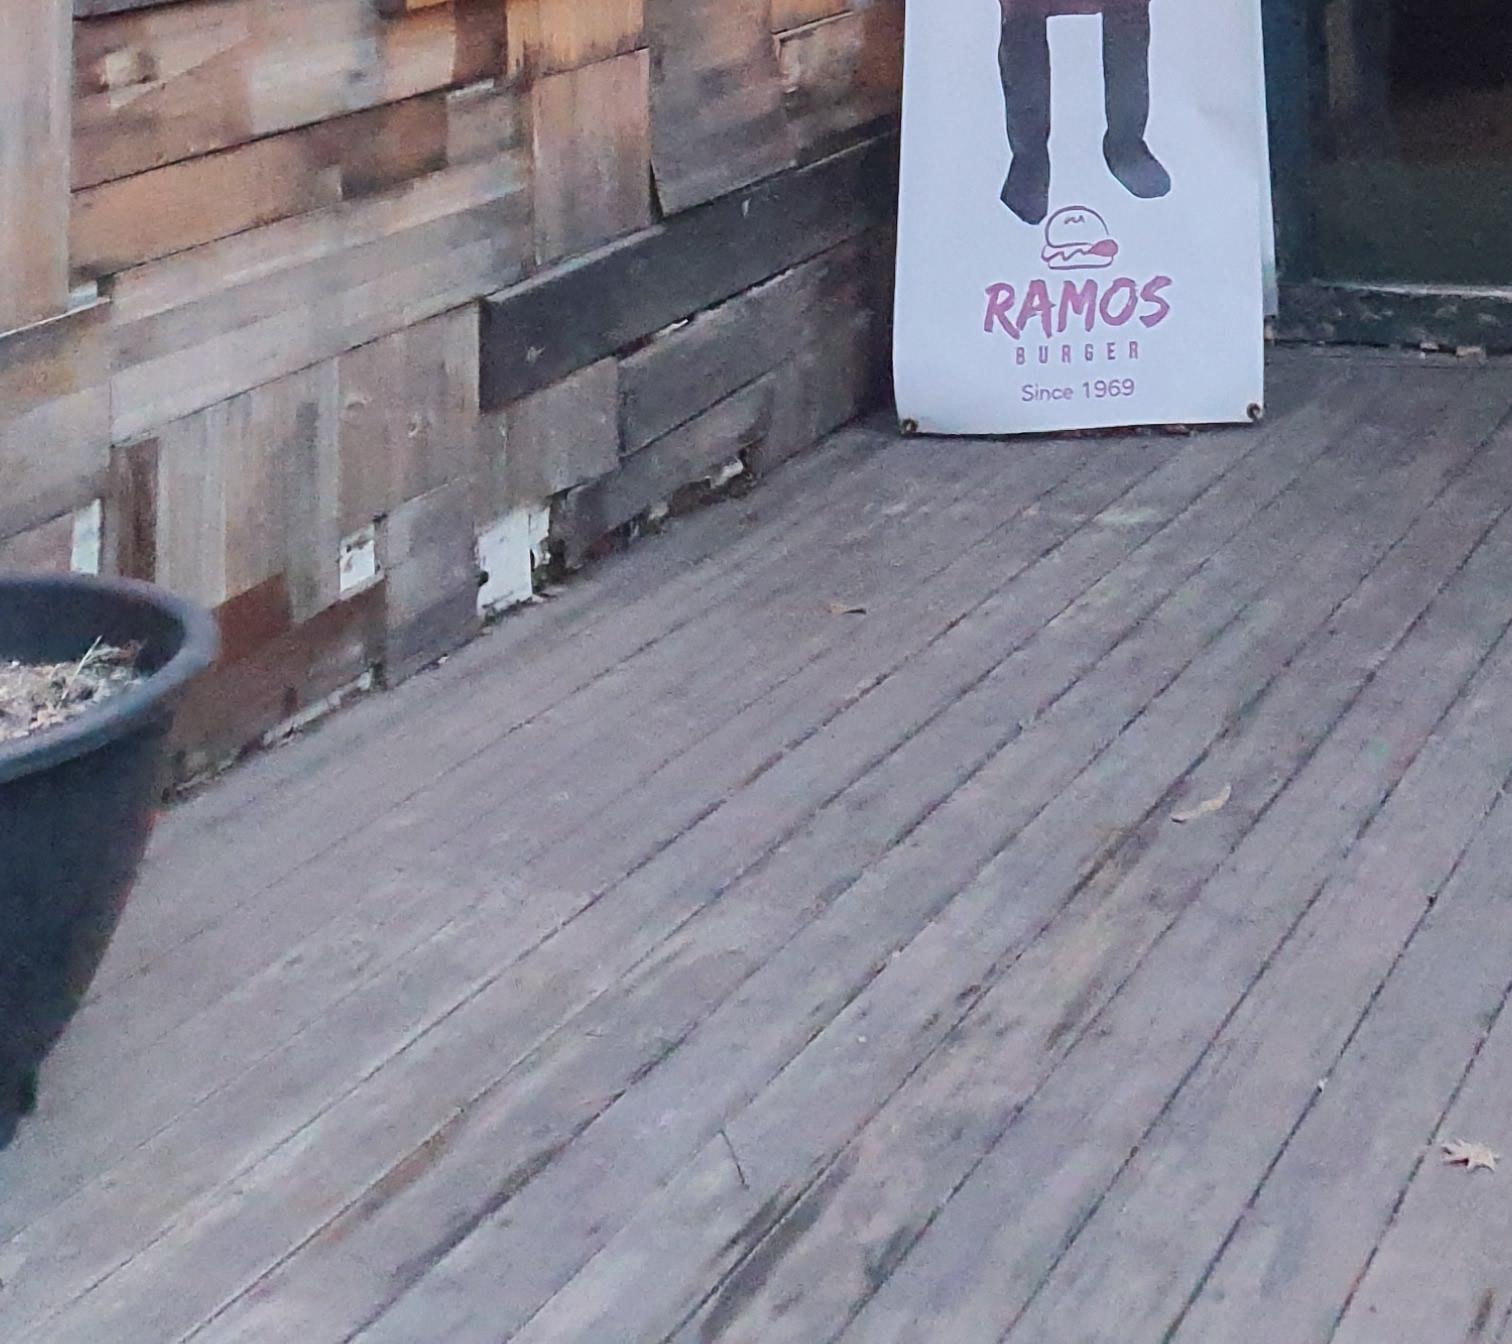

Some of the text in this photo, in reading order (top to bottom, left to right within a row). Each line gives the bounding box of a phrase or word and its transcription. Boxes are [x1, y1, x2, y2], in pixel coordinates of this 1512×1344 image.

[984, 275, 1172, 340] RAMOS
[1016, 341, 1138, 364] BURGER
[1021, 378, 1135, 401] Since 1969
